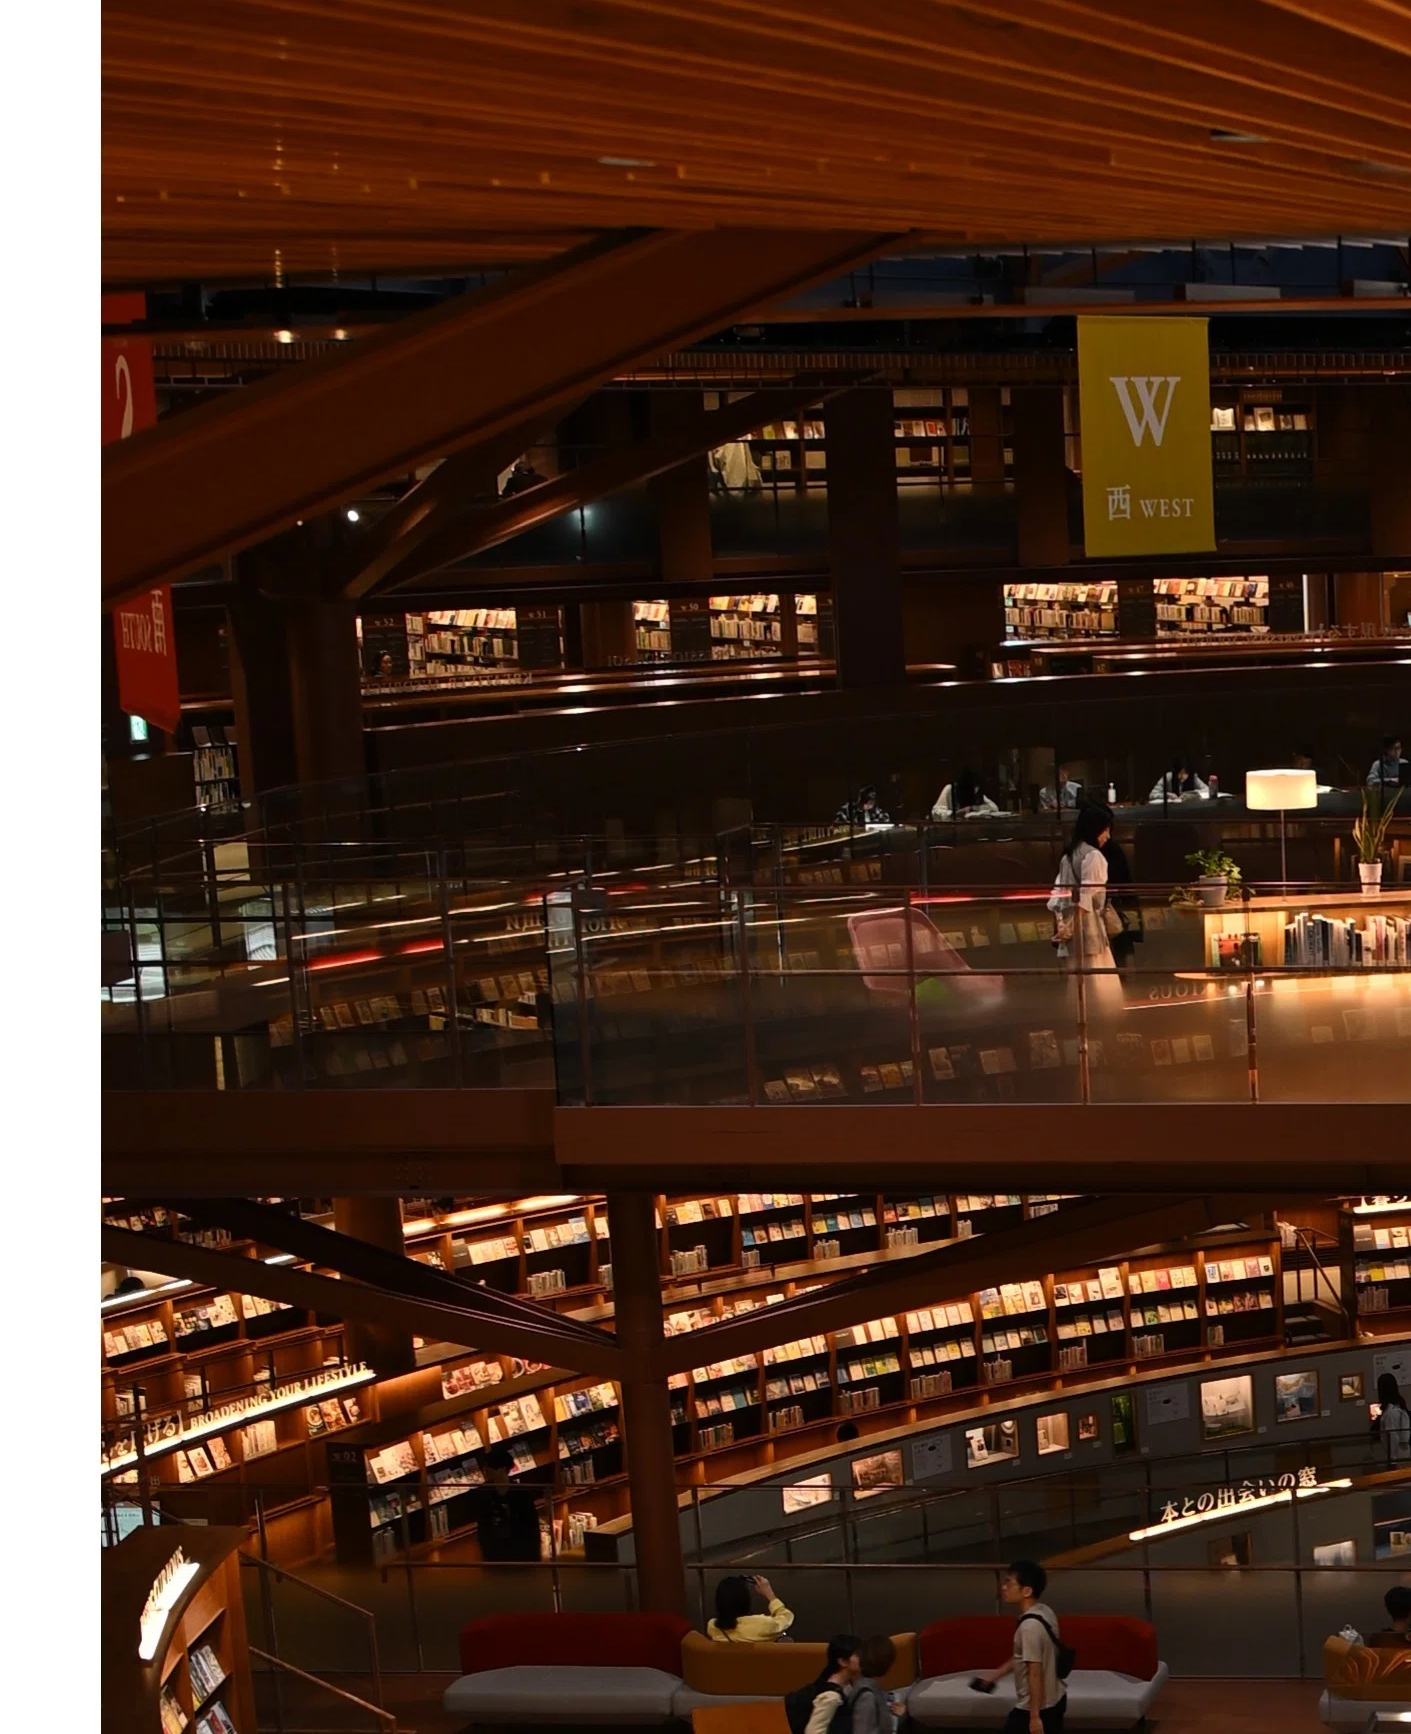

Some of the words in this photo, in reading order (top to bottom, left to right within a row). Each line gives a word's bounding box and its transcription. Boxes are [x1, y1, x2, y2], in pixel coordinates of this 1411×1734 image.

[1108, 376, 1181, 447] W
[1106, 484, 1131, 521] 西
[1139, 498, 1194, 518] WEST
[190, 1394, 269, 1429] BROADENING
[268, 1380, 303, 1403] YOUR
[303, 1361, 369, 1389] LIFESTYLE
[1160, 1466, 1318, 1523] 本との出会いの窓
